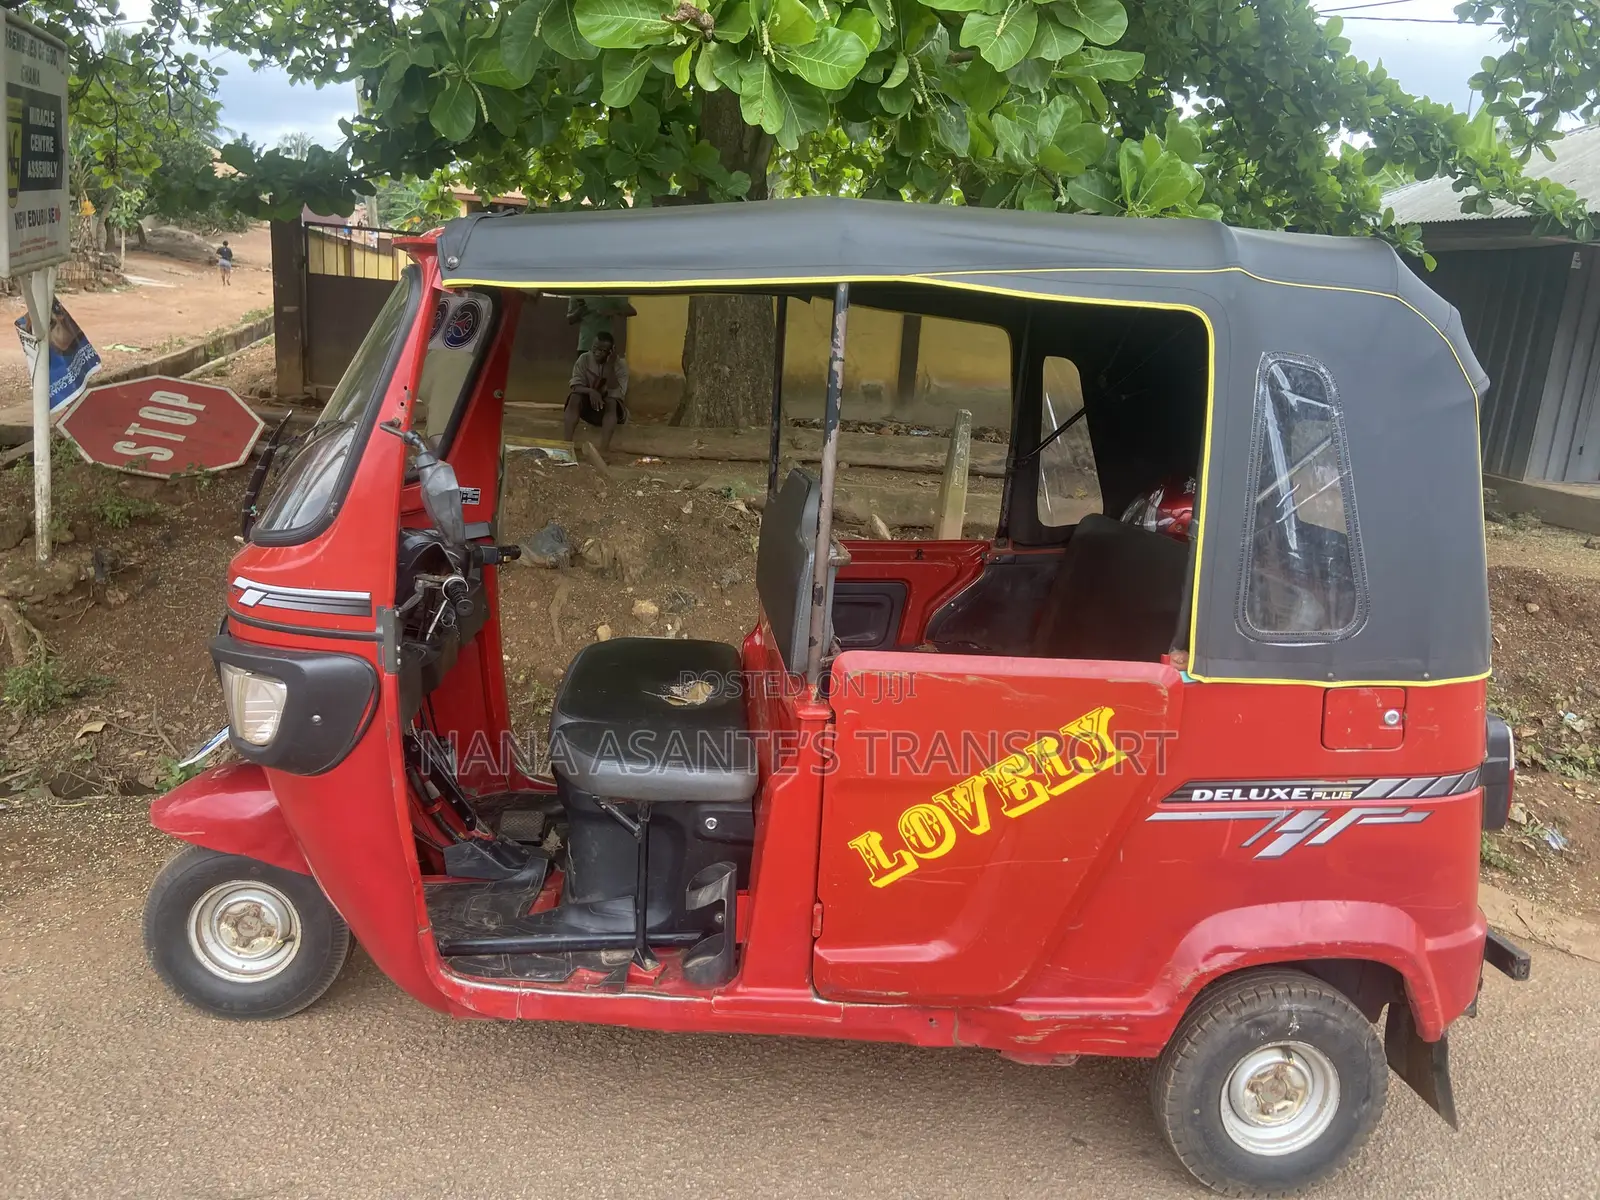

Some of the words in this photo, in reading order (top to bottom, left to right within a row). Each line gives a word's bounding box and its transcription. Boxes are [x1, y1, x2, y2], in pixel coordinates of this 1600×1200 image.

[20, 64, 41, 87] GHANA
[29, 106, 56, 128] MIRACLE
[30, 133, 55, 153] CENTRE
[27, 160, 59, 178] ASSEMBLY
[113, 390, 206, 462] STOP
[847, 705, 1129, 888] LOVELY
[1191, 787, 1312, 802] DELUXE
[1312, 791, 1353, 801] PLUS
